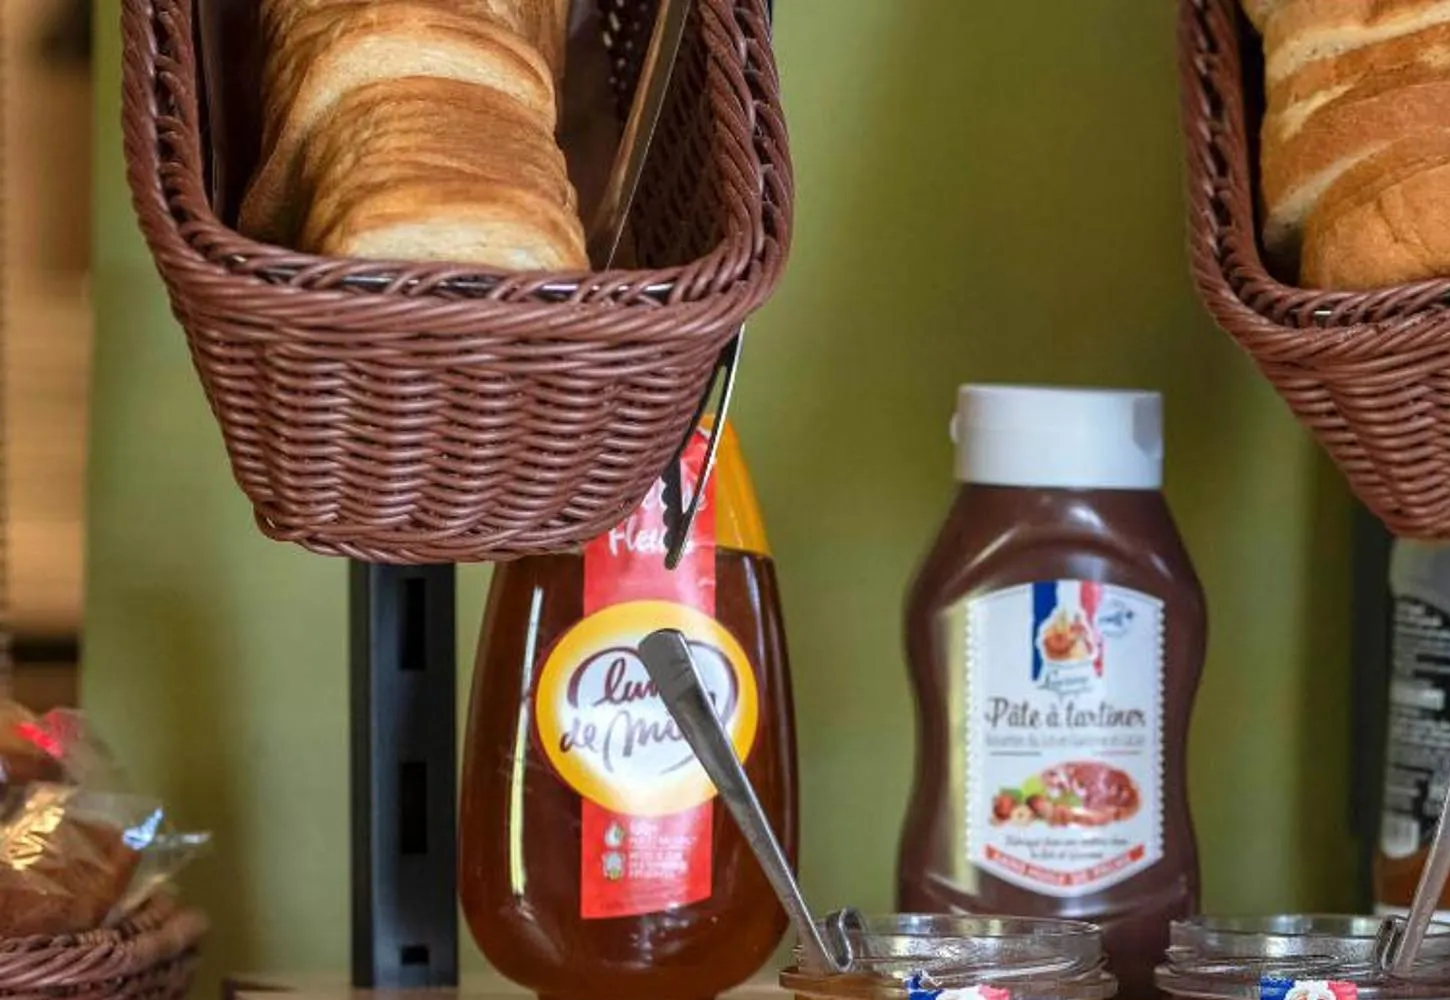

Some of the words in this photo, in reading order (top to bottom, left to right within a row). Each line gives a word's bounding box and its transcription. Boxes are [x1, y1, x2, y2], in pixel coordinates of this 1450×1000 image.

[985, 697, 1039, 728] Pâte
[1046, 704, 1060, 727] à
[1065, 702, 1146, 728] tartiner
